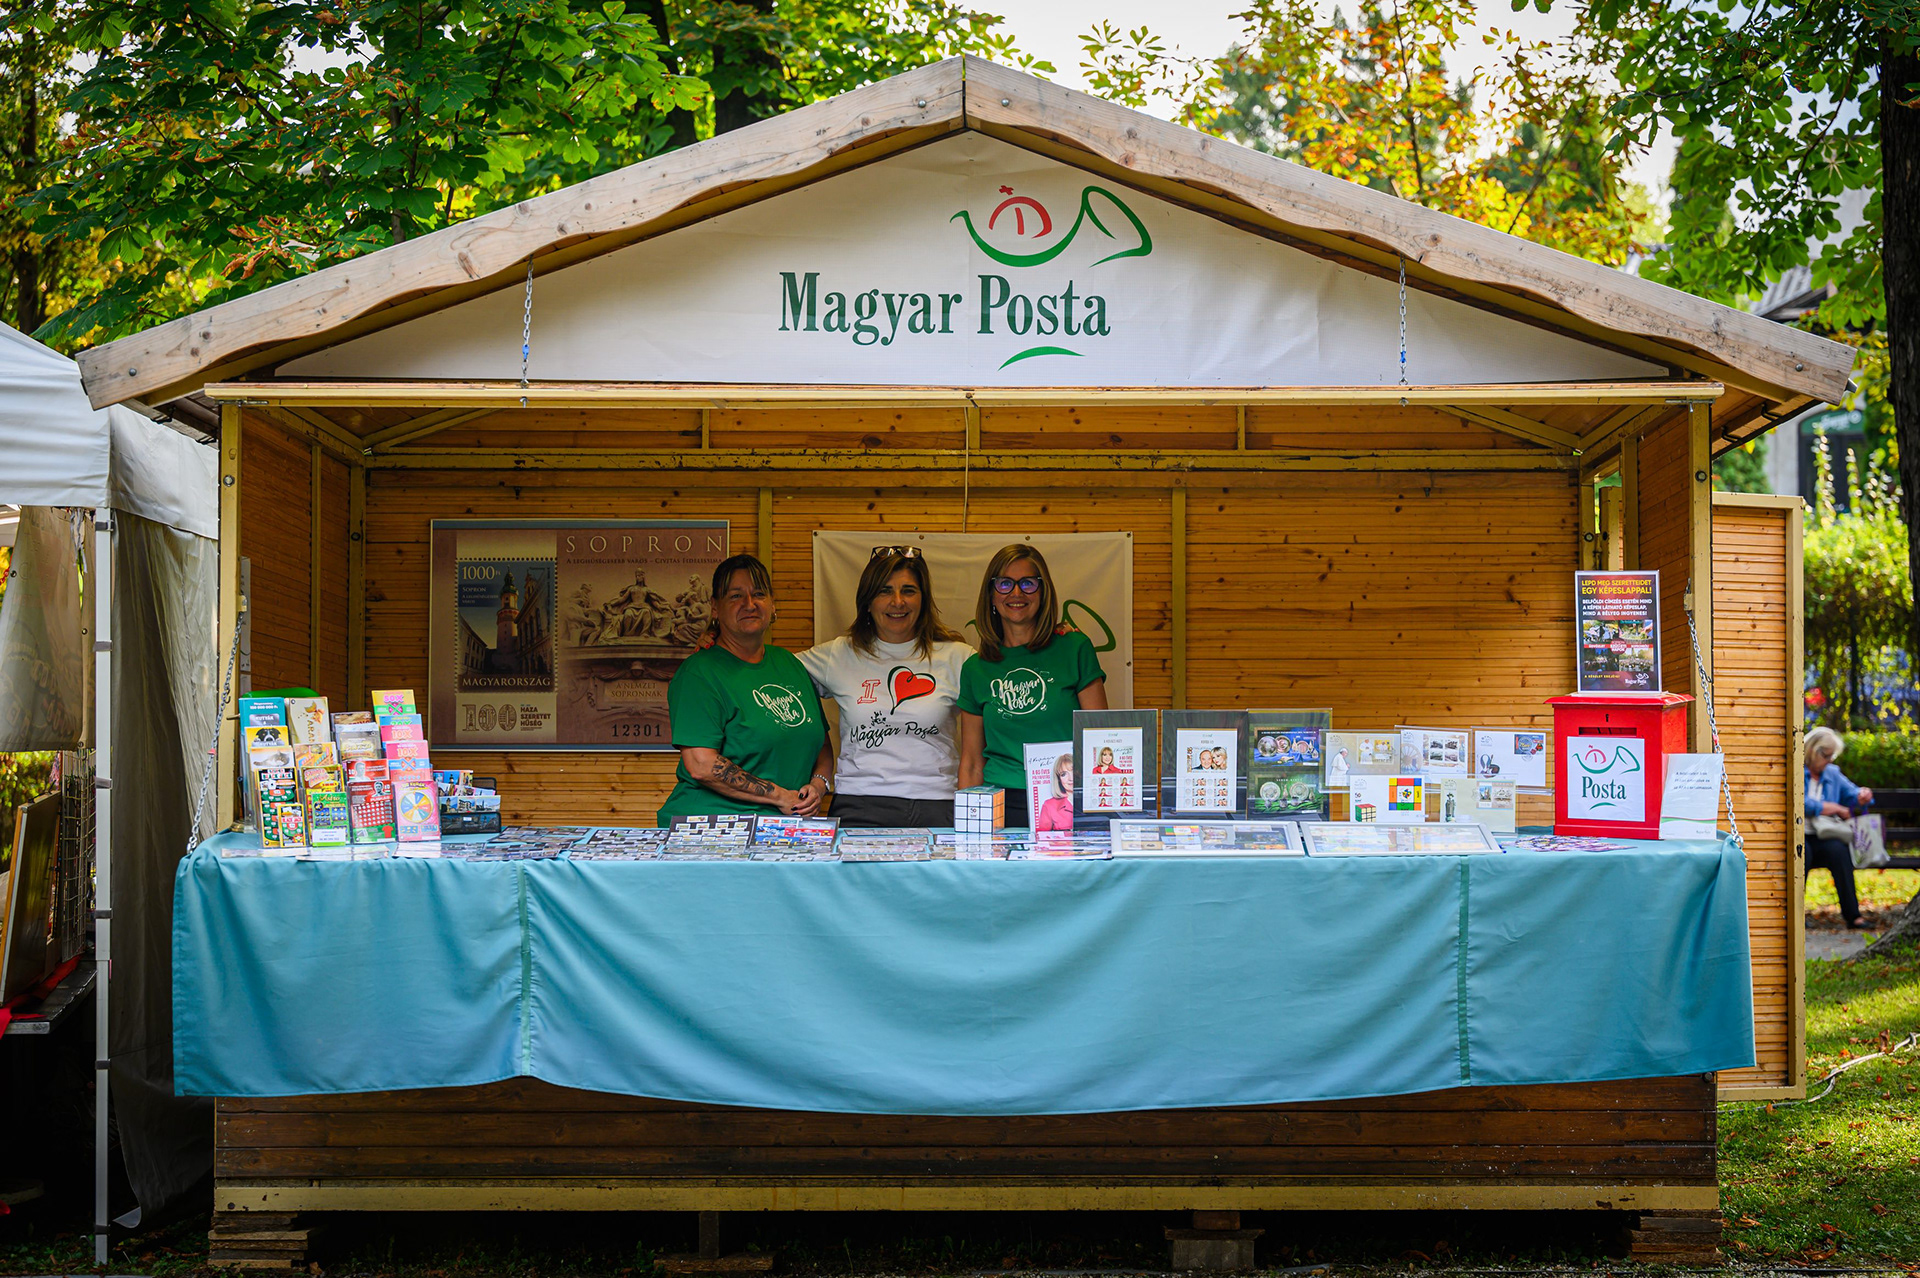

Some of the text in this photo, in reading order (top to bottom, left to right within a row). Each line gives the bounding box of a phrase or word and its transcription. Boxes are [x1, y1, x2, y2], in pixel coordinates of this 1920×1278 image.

[777, 271, 1111, 346] Magyar Posta
[566, 535, 722, 553] SOPRON
[462, 565, 495, 580] 1000
[1581, 586, 1652, 595] EGY KÉPESLAPPAL!
[462, 674, 551, 687] MAGYARORSZÁG
[990, 678, 1040, 698] Magyar
[384, 694, 404, 703] 50X
[611, 689, 663, 697] SOPRONNAK
[857, 679, 881, 704] I
[1001, 689, 1036, 710] Posta
[462, 703, 517, 731] 100
[391, 729, 413, 739] 10X
[612, 723, 662, 737] 12301
[397, 747, 418, 757] 10X
[1582, 776, 1627, 799] Posta
